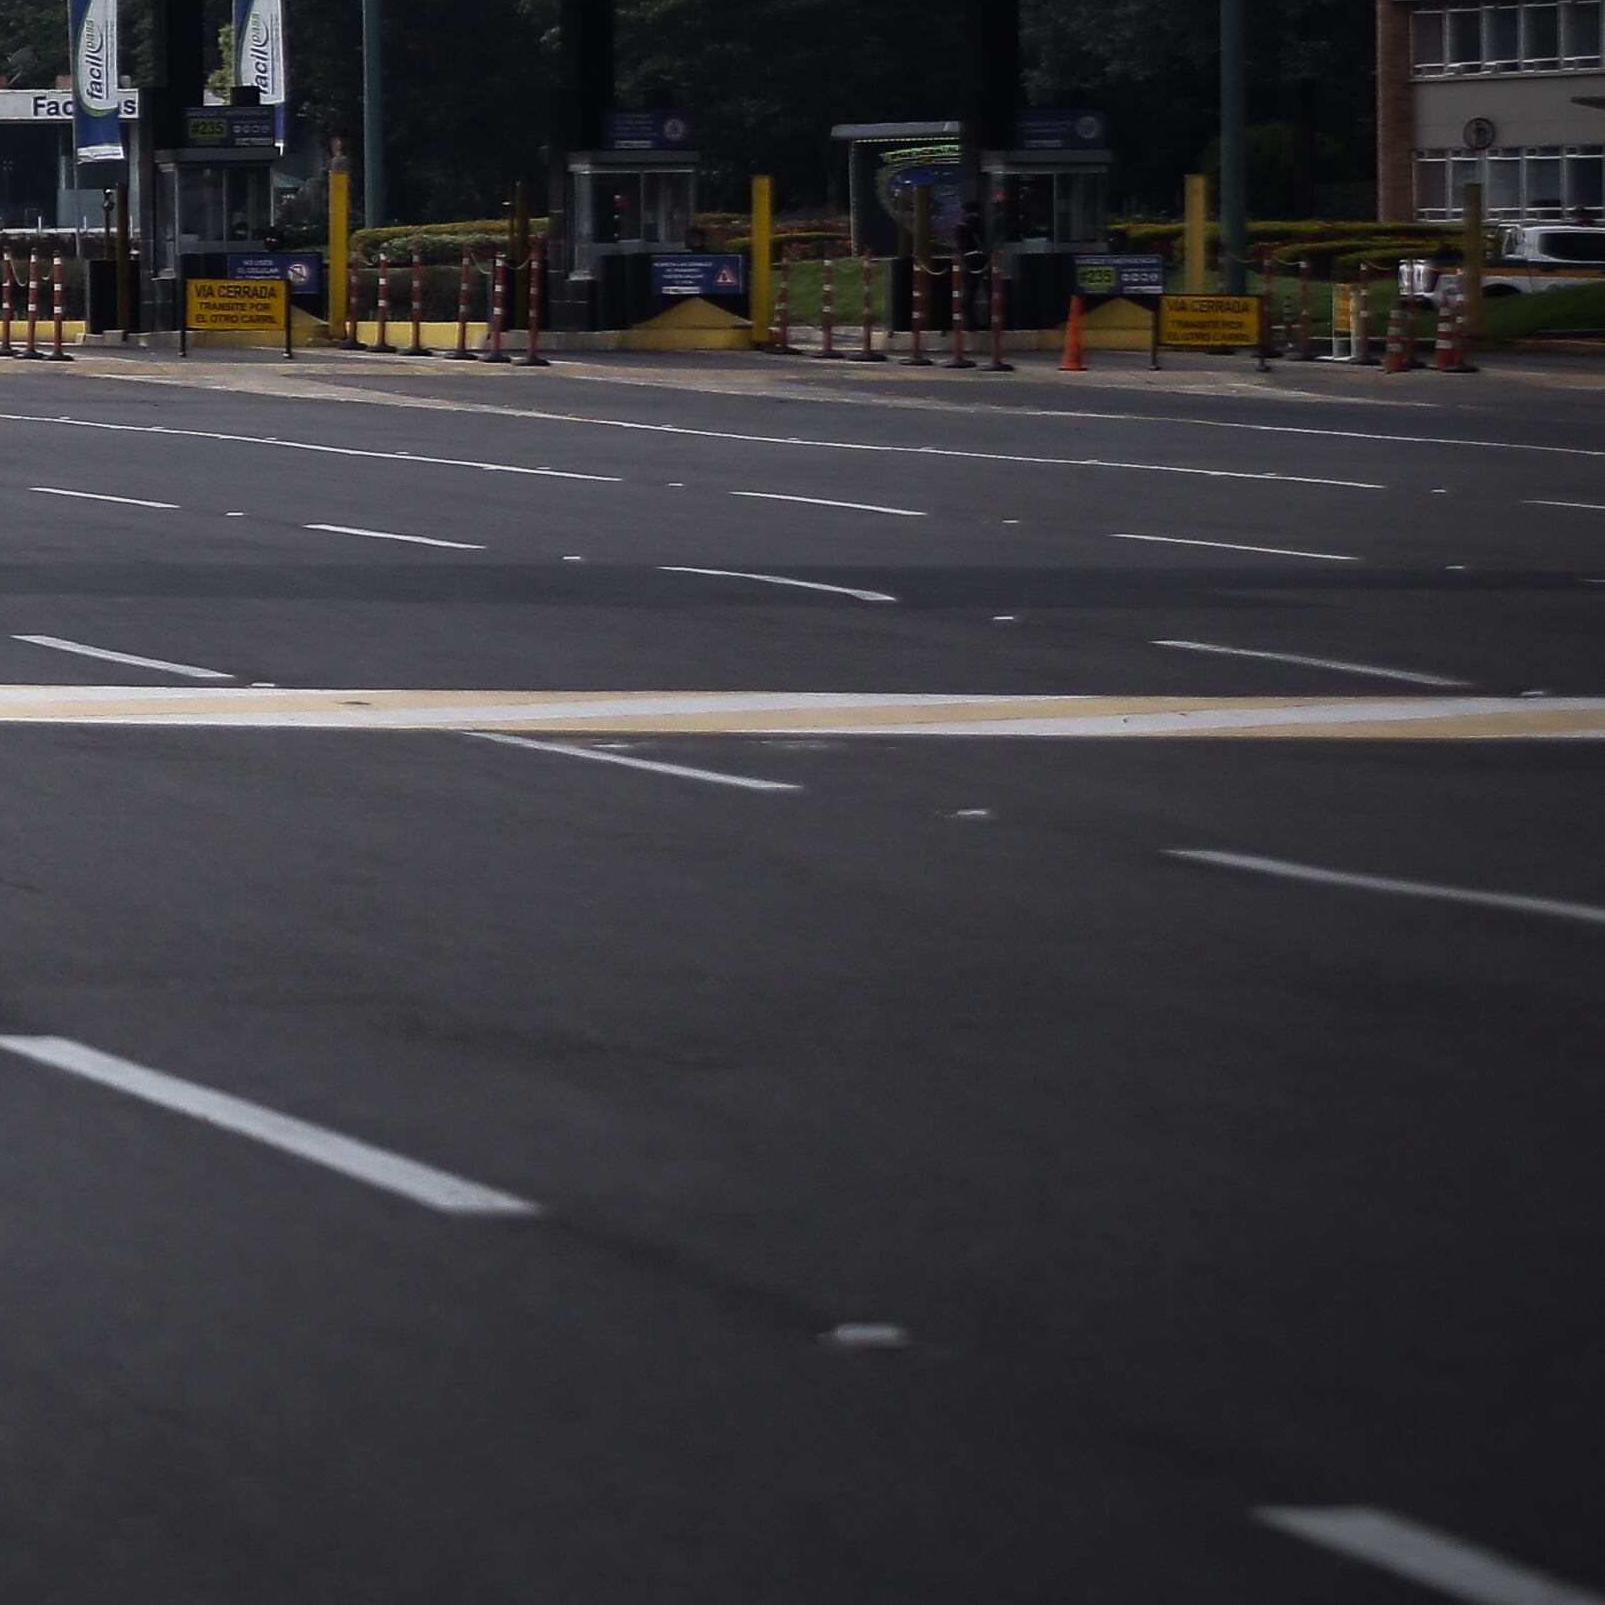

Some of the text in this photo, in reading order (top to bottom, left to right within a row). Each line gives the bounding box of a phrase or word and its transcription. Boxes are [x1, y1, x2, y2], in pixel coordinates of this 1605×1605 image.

[85, 19, 103, 99] facil pass
[191, 121, 223, 134] #235
[1078, 269, 1112, 283] #235
[195, 285, 277, 299] VIA CERRADA
[198, 302, 270, 311] TRANSITE POR
[196, 314, 277, 324] EL OTRO CARRIL
